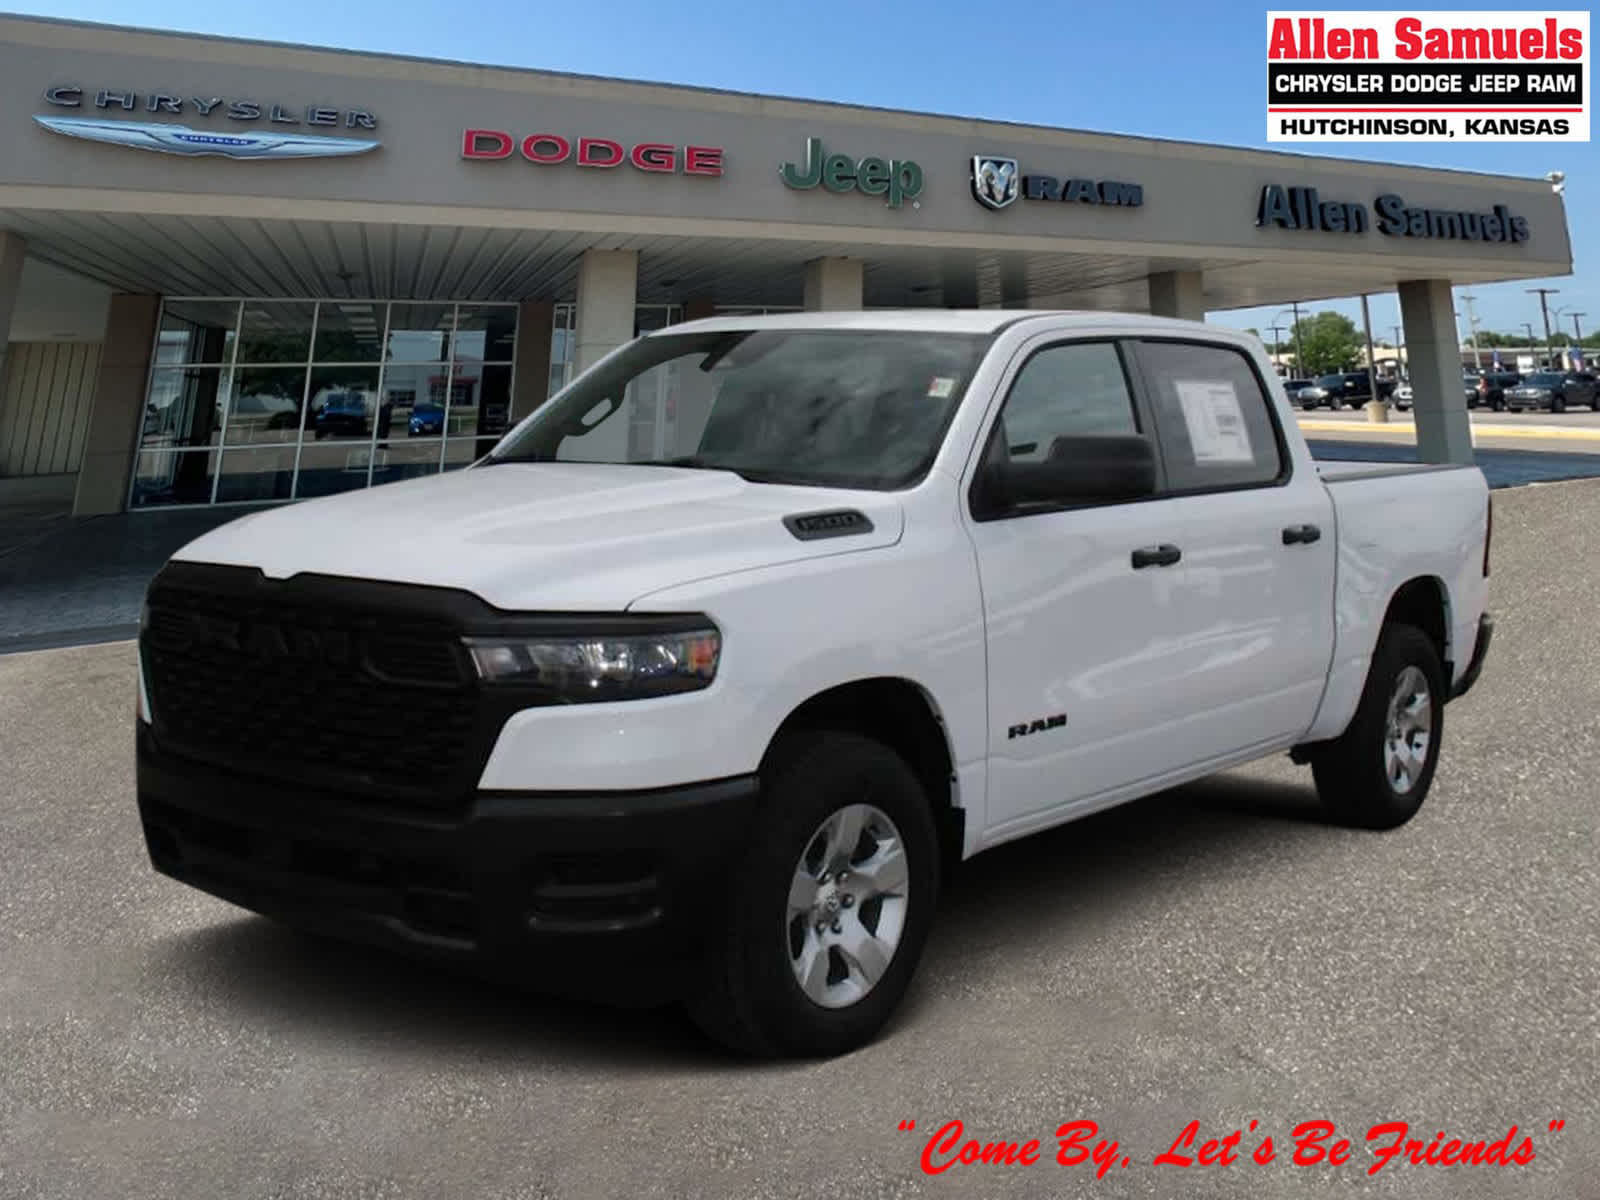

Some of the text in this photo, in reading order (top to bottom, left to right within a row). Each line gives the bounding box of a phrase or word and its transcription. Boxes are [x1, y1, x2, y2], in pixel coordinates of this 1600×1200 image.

[44, 86, 378, 128] CHRYSLER
[461, 128, 724, 177] DODGE
[780, 137, 923, 208] Jeep
[1022, 174, 1144, 207] RAM
[1257, 184, 1531, 243] Allen Samuels
[1008, 713, 1067, 740] RAM
